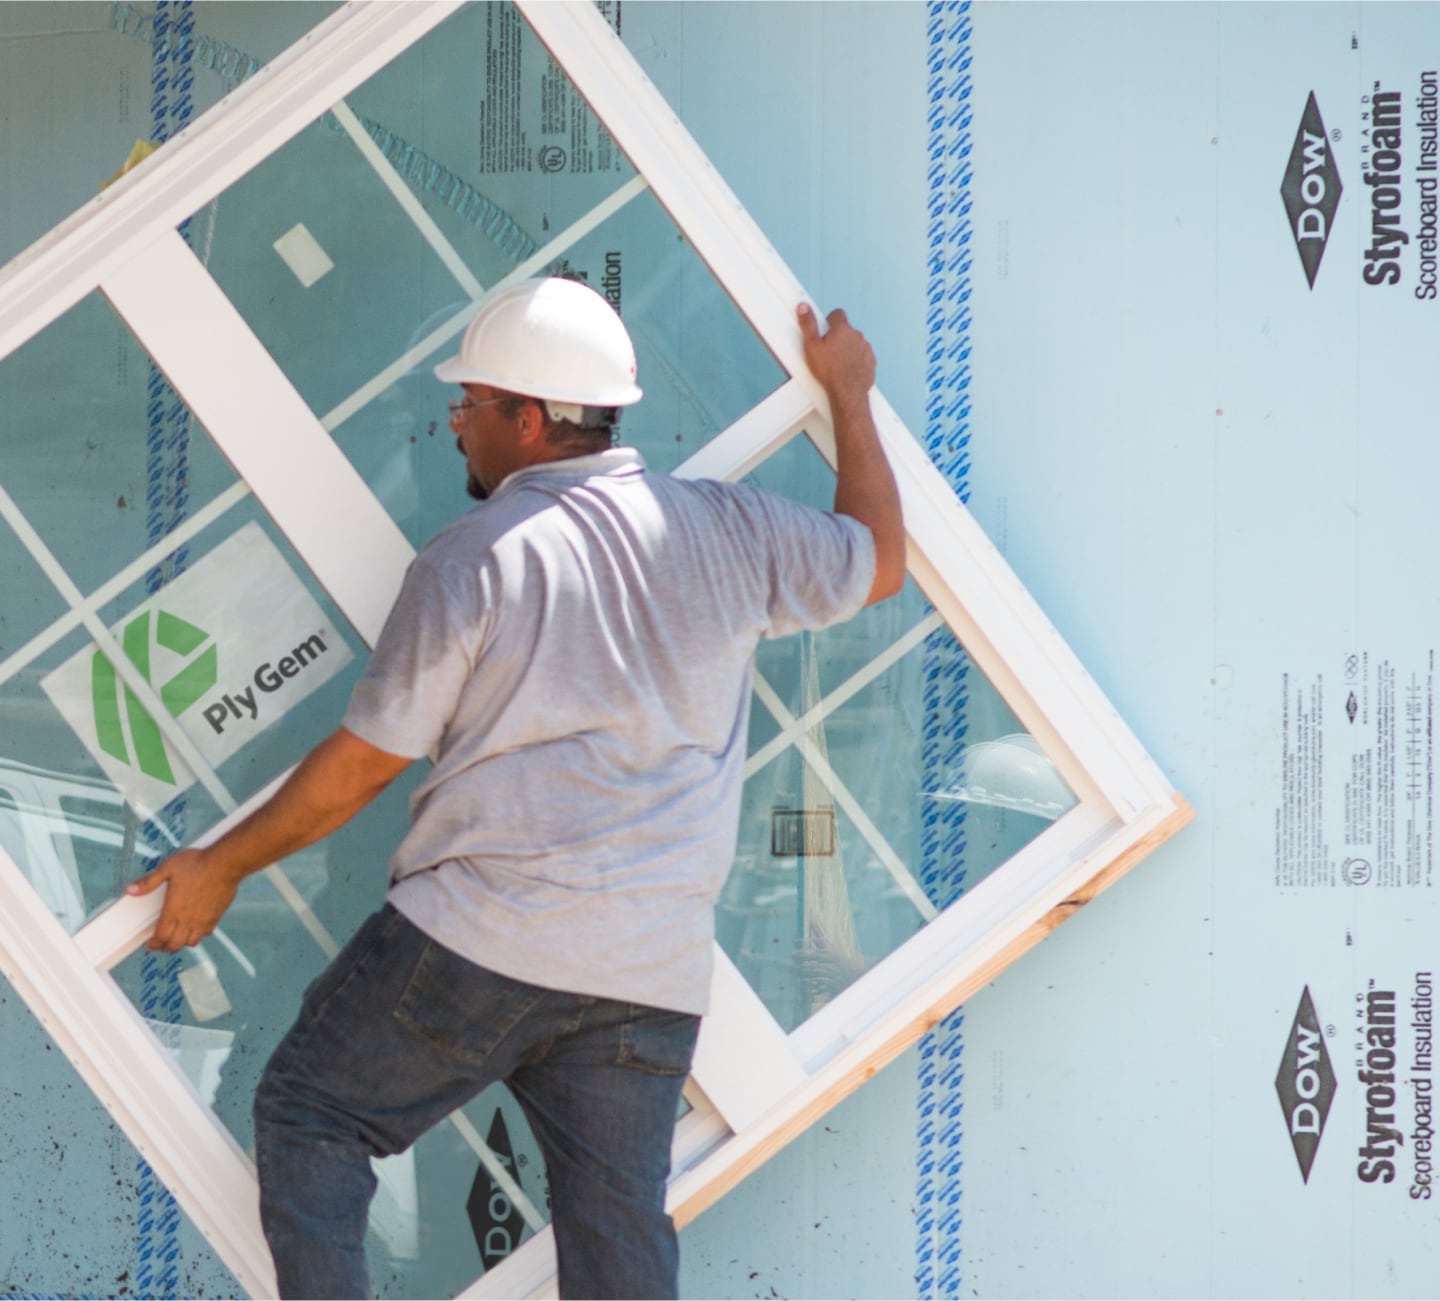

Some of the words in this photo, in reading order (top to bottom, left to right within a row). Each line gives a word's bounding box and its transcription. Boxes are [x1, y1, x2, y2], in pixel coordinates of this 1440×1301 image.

[1361, 95, 1370, 170] BRAND
[1416, 71, 1439, 171] Insulation
[1297, 128, 1327, 242] DOW
[1363, 91, 1410, 285] Styrofoam
[1415, 177, 1438, 300] Scoreboard
[202, 685, 258, 735] Ply
[254, 634, 328, 693] Gem
[1410, 971, 1433, 1071] Insulation
[1292, 1024, 1321, 1136] DOW
[1357, 990, 1404, 1184] Styrofoam
[1410, 1078, 1433, 1200] Scoreboard
